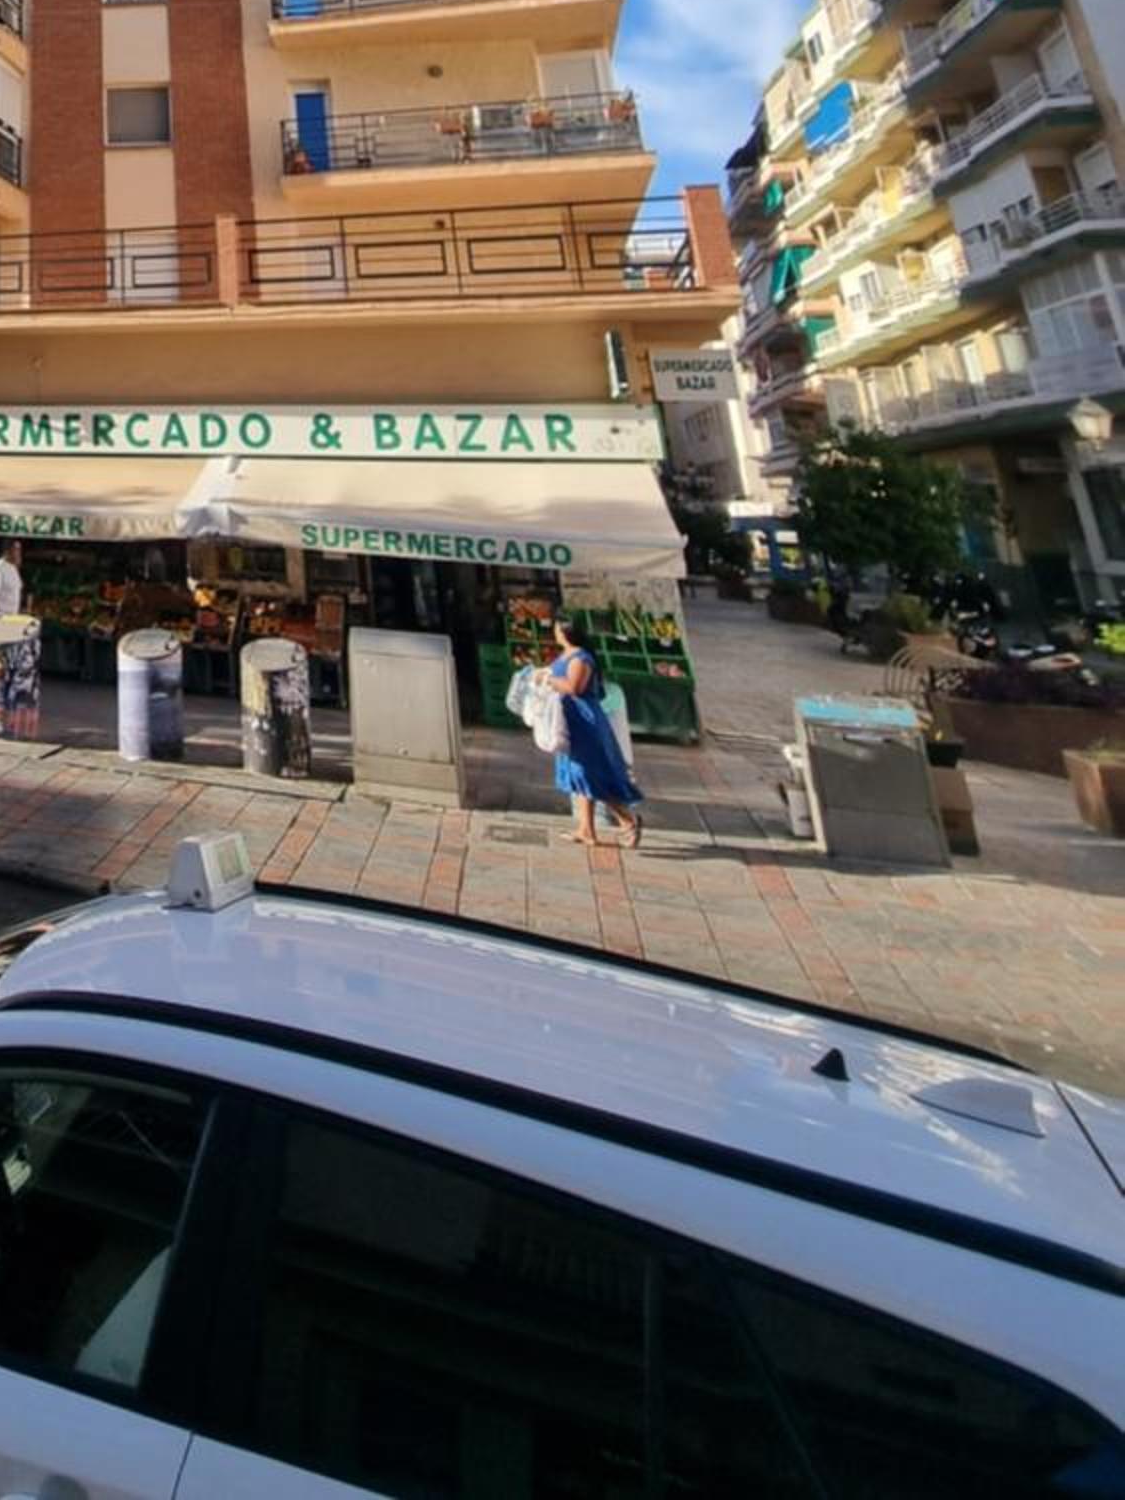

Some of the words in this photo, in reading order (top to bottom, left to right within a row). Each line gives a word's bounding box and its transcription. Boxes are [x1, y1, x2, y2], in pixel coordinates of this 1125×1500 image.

[654, 359, 733, 373] SUPERMERCADO
[675, 375, 716, 390] BAZAR
[309, 412, 343, 450] &
[373, 412, 578, 452] BAZAR
[301, 523, 573, 567] SUPERMERCADO
